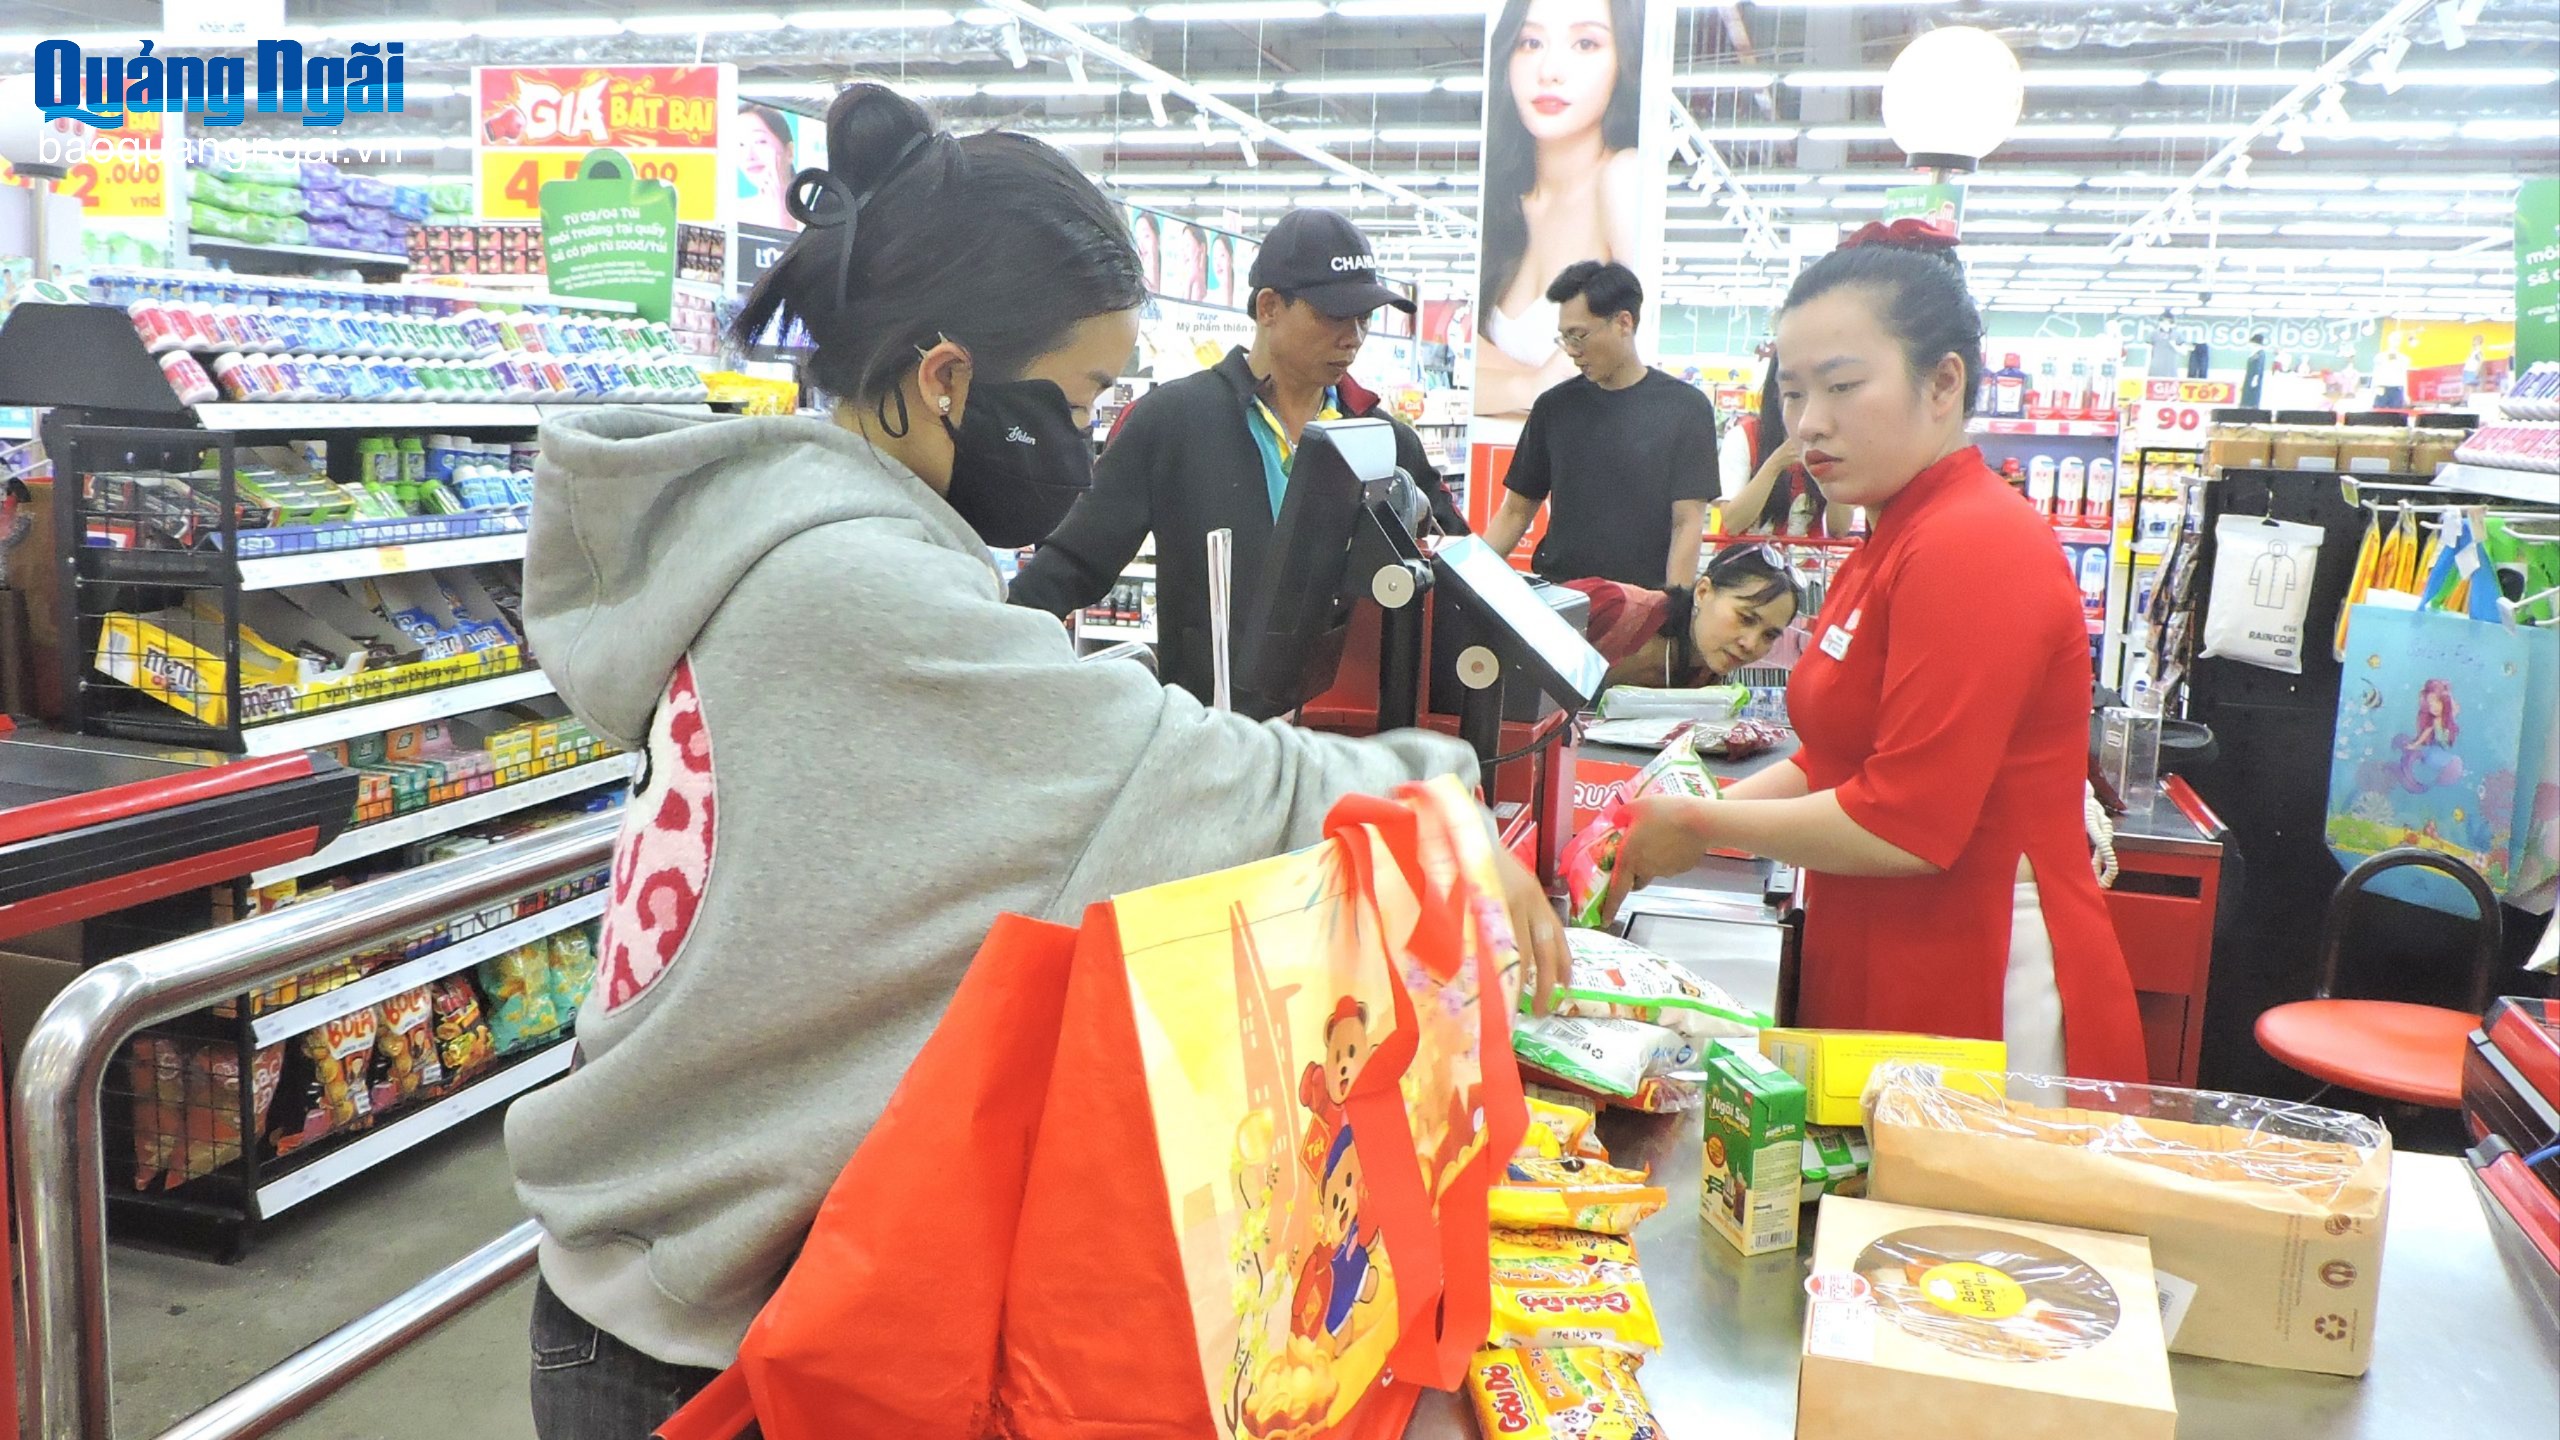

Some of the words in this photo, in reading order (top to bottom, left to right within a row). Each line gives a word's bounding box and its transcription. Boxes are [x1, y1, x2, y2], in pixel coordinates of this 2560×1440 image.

[516, 71, 609, 141] GIÁ
[609, 77, 663, 129] BẤT
[668, 98, 714, 141] BẠI
[131, 192, 161, 207] vnd
[563, 213, 579, 226] Từ
[580, 207, 618, 221] 09/04
[620, 206, 641, 219] Túi
[548, 230, 571, 246] môi
[571, 224, 614, 240] trường
[615, 222, 633, 235] tại
[635, 222, 666, 239] quầy
[566, 245, 579, 258] có
[580, 242, 599, 258] phí
[600, 238, 614, 252] từ
[2281, 318, 2320, 346] bé
[2157, 408, 2200, 430] 90
[2248, 631, 2296, 646] RAINCOAT
[1711, 1097, 1735, 1118] Ngôi
[1735, 1106, 1751, 1128] Sao
[1957, 1278, 1978, 1303] Bánh
